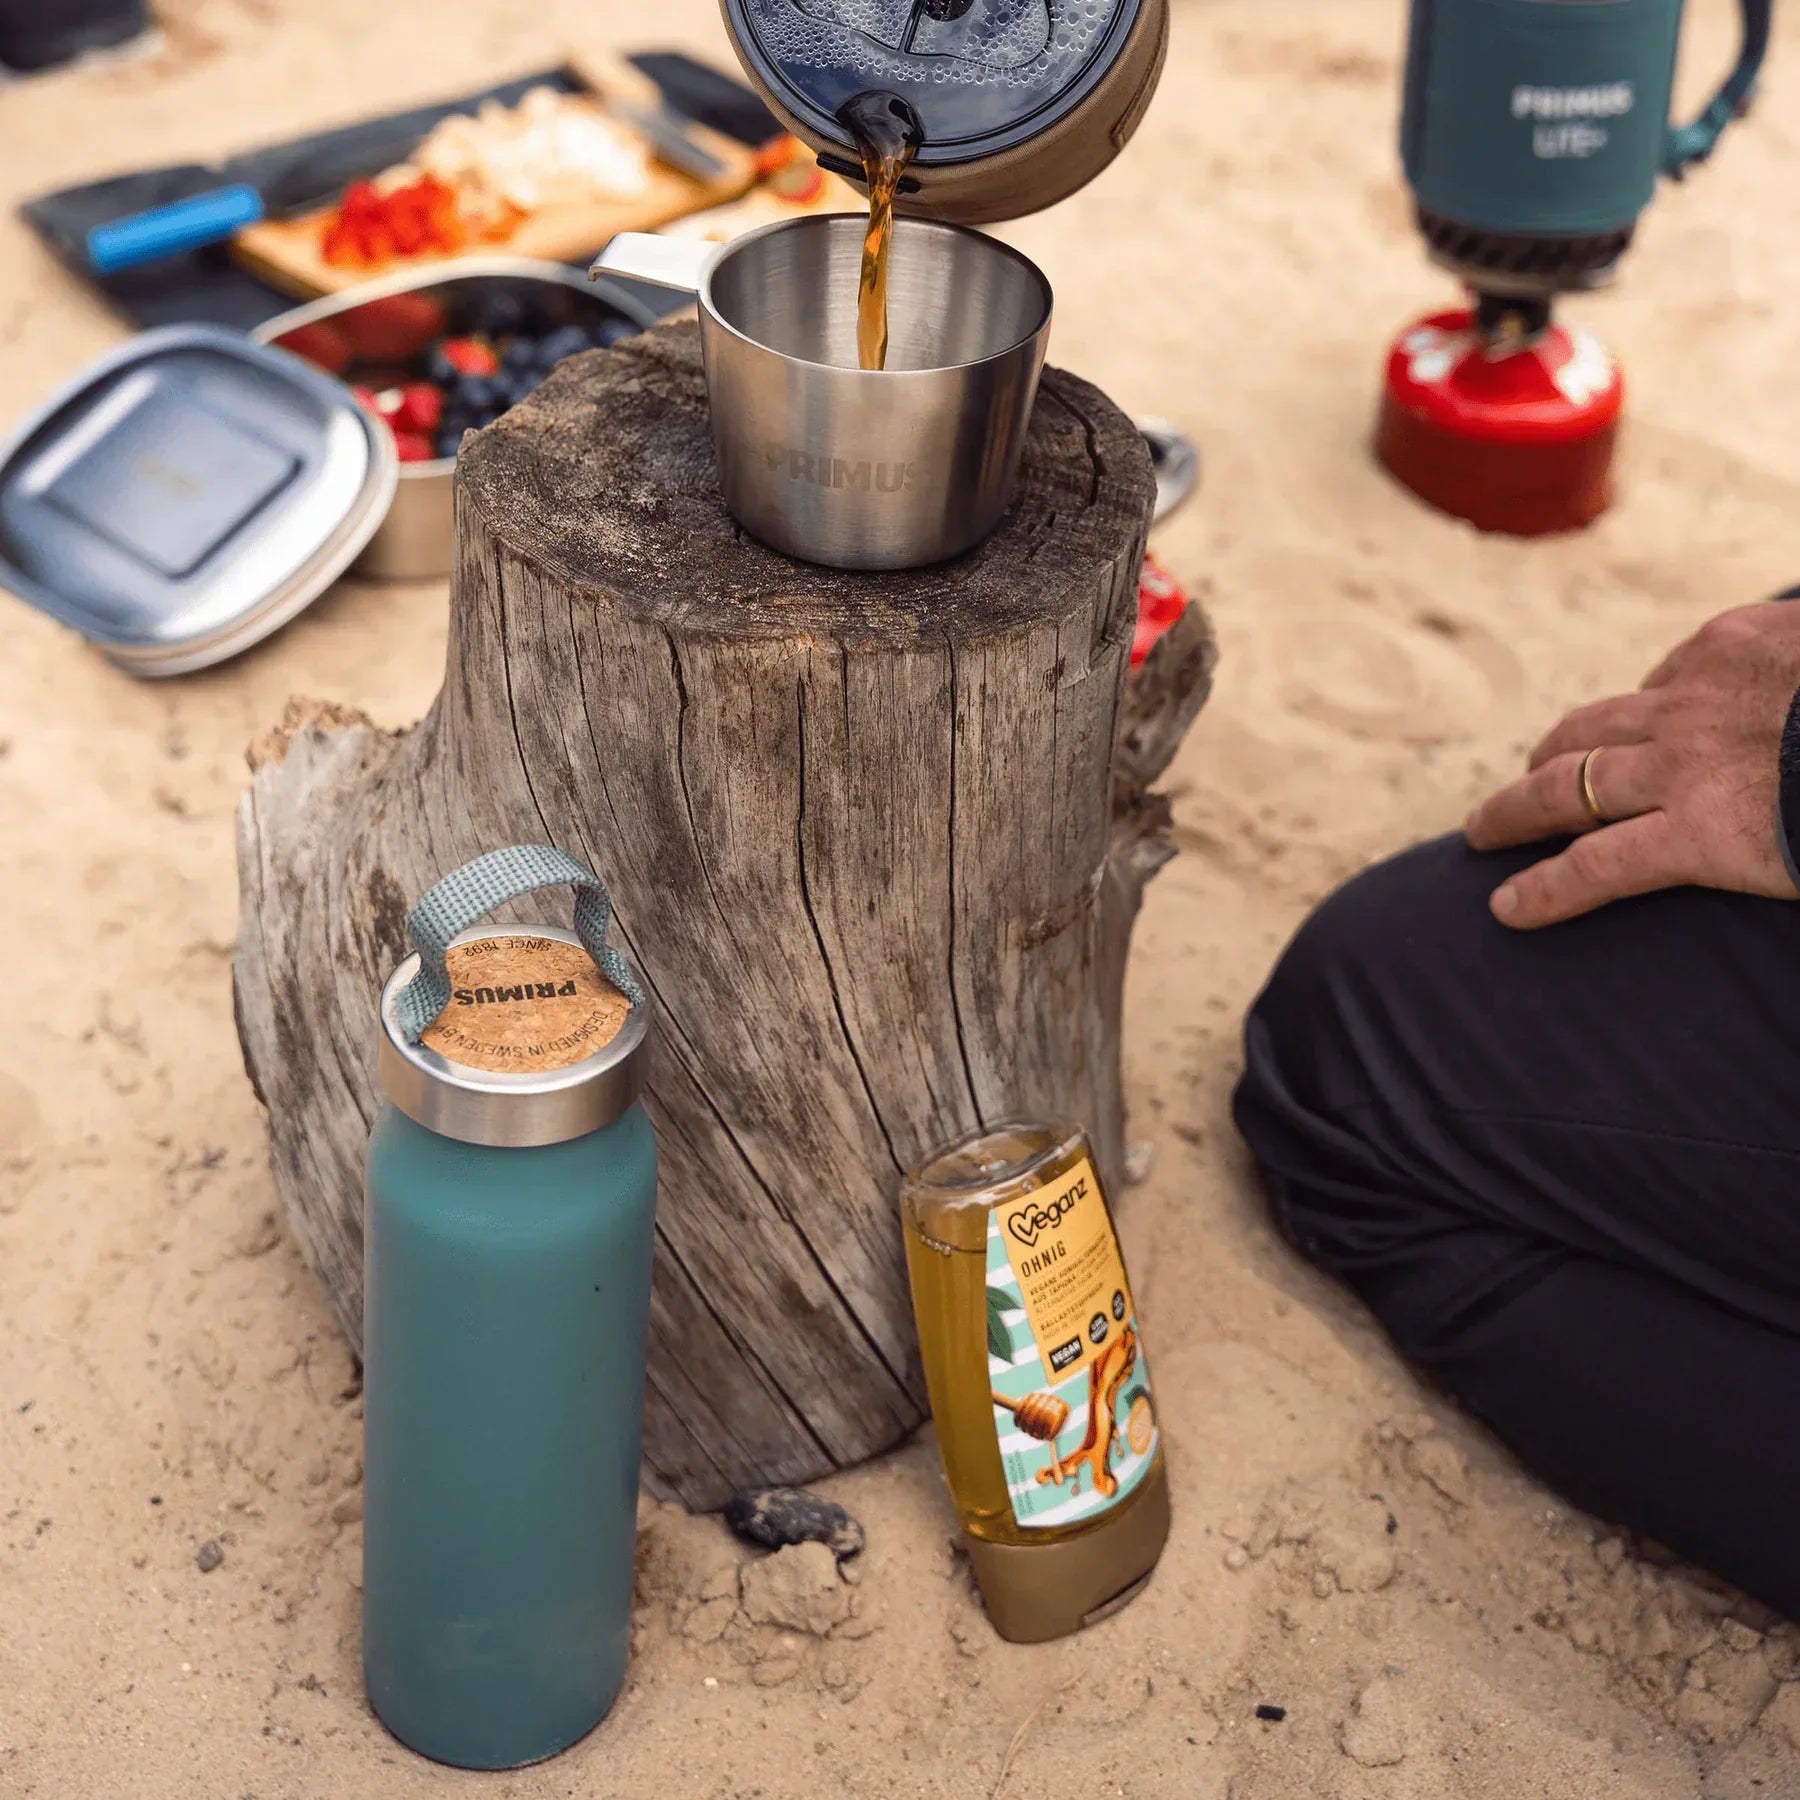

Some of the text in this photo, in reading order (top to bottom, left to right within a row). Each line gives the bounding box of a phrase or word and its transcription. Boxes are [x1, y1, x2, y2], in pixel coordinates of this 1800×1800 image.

[464, 938, 552, 958] SINCE 1892
[453, 980, 577, 1006] PRIMUS
[549, 1009, 609, 1052] DESIGNED
[457, 1032, 523, 1058] SWEDEN
[528, 1041, 546, 1057] IN
[1008, 1177, 1089, 1247] Veganz
[1021, 1240, 1066, 1277] OHNIG
[1051, 1339, 1080, 1364] VEGAN
